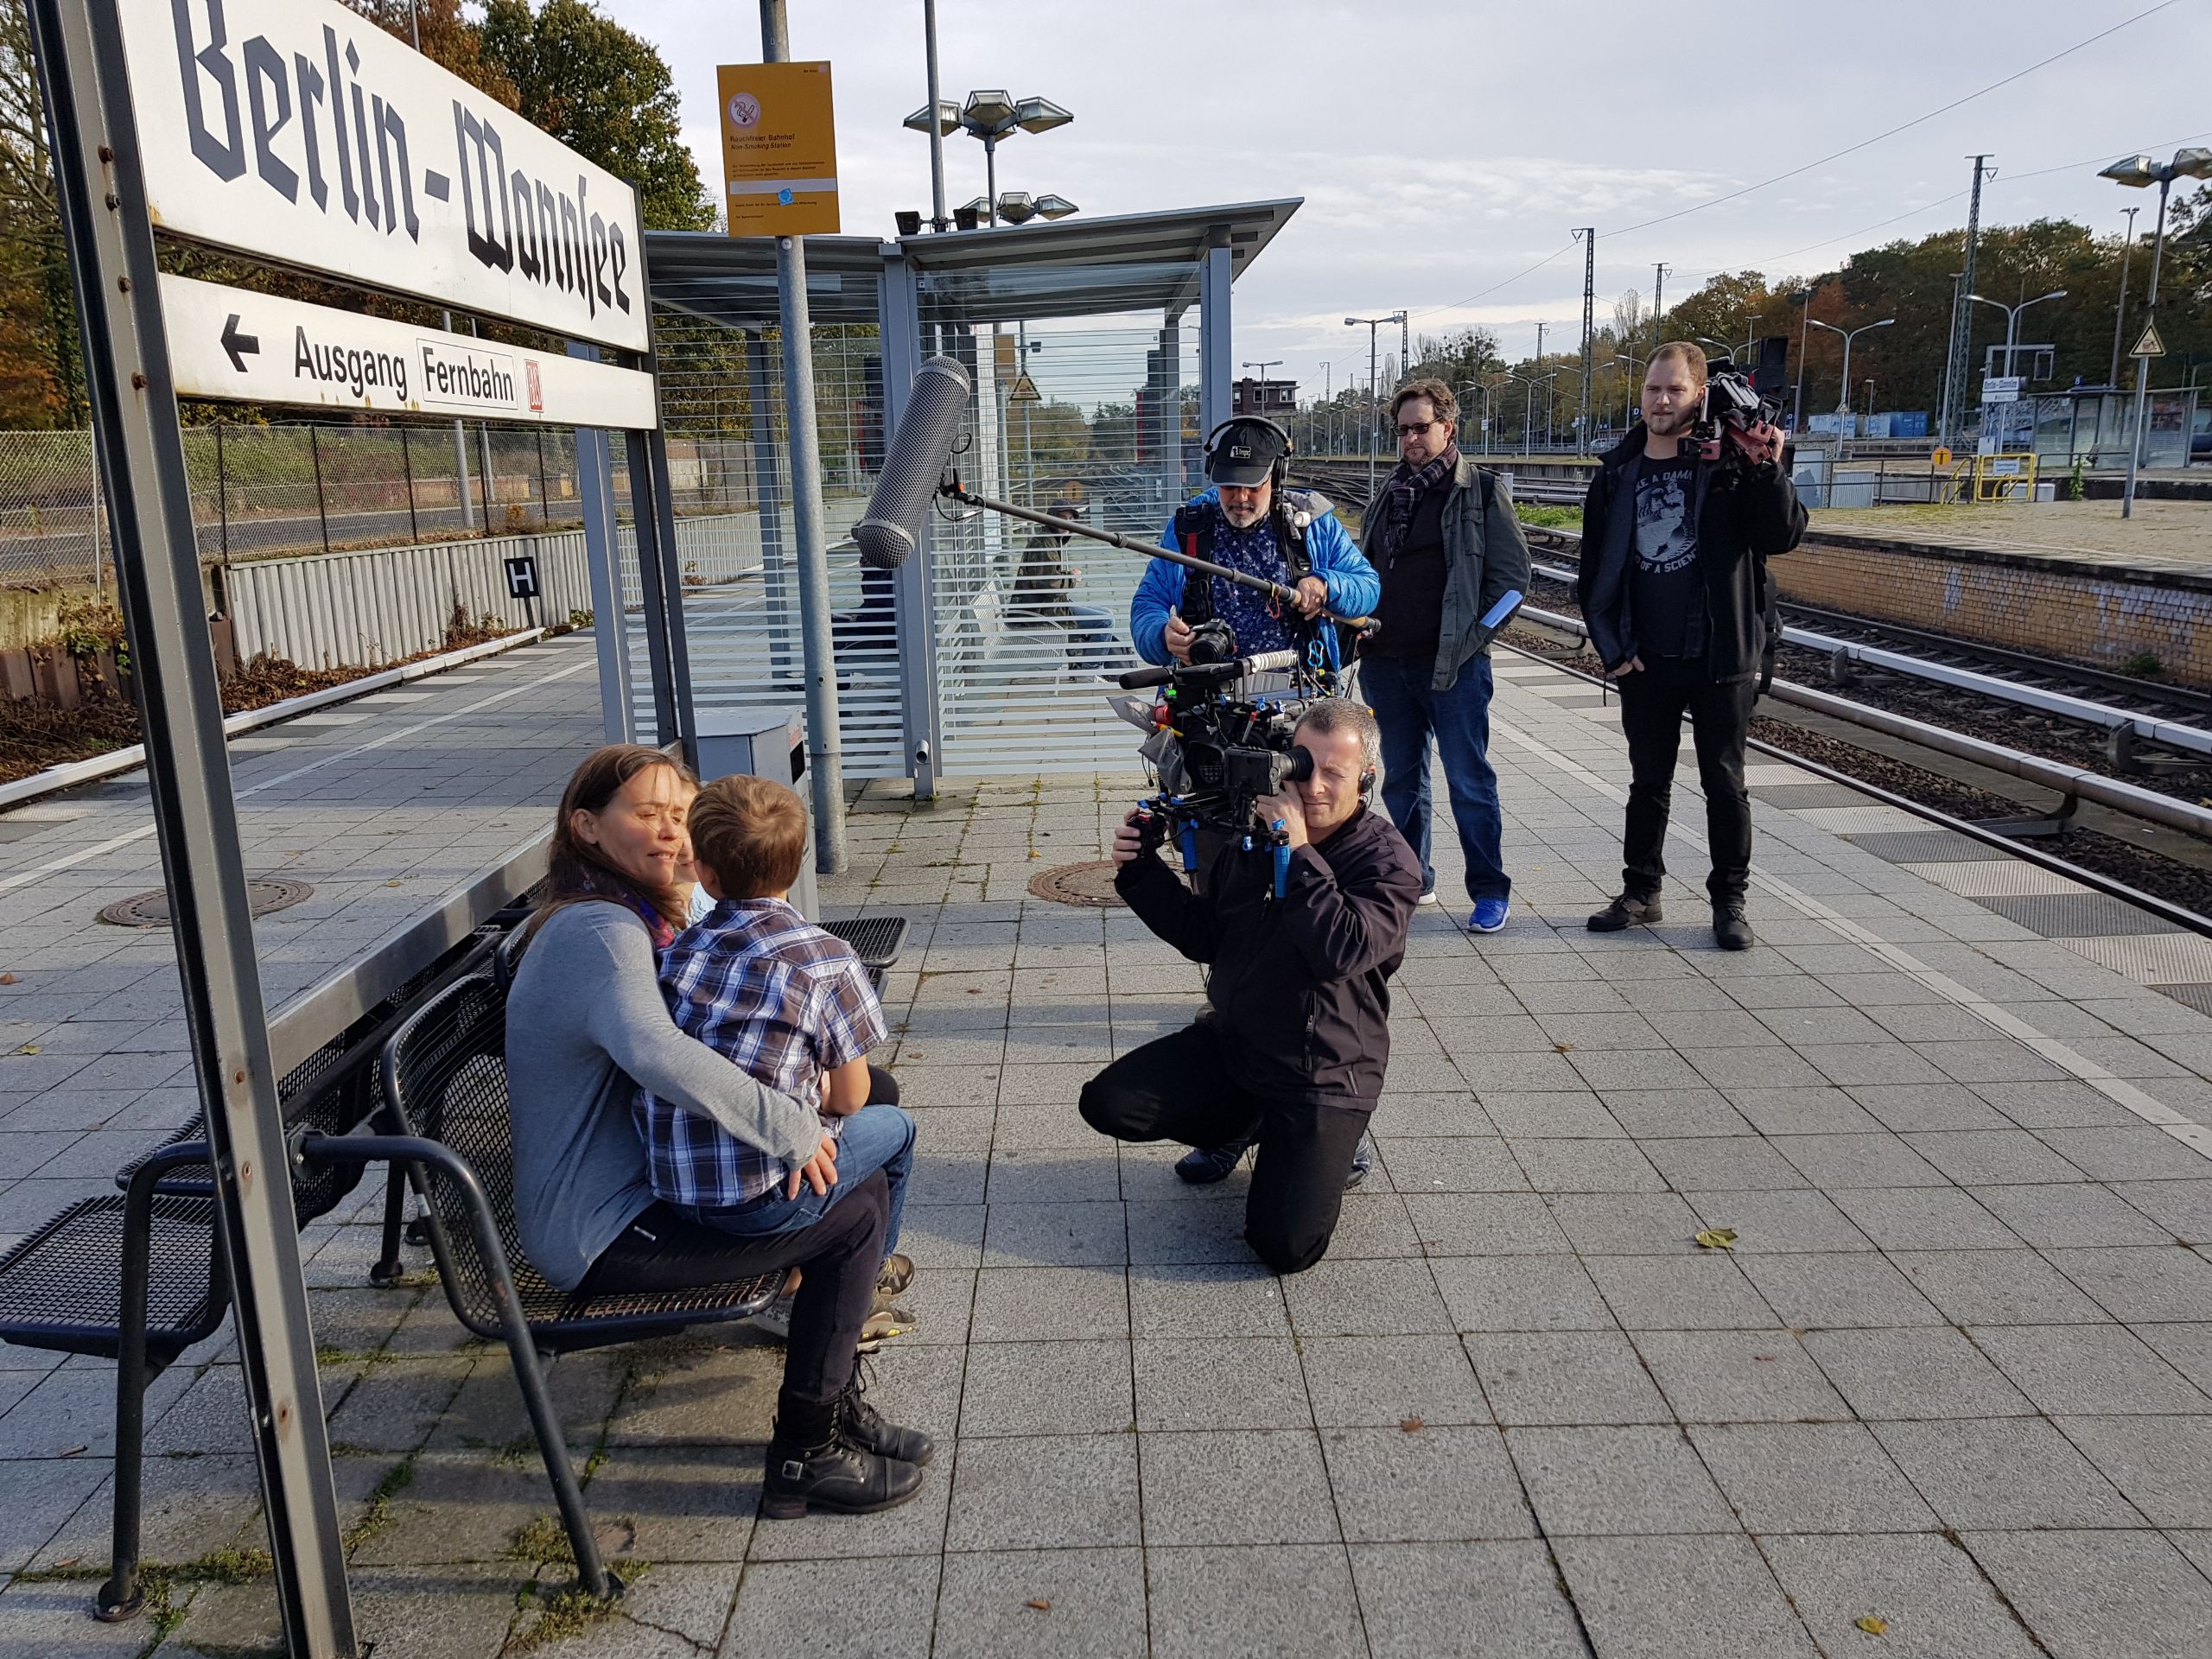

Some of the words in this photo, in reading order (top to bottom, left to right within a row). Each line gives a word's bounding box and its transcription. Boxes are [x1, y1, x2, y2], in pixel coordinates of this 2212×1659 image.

[295, 325, 408, 402] Ausgang
[423, 346, 514, 402] Fernbahn
[508, 561, 535, 594] H
[1641, 561, 1652, 571] OF
[1654, 564, 1660, 574] A
